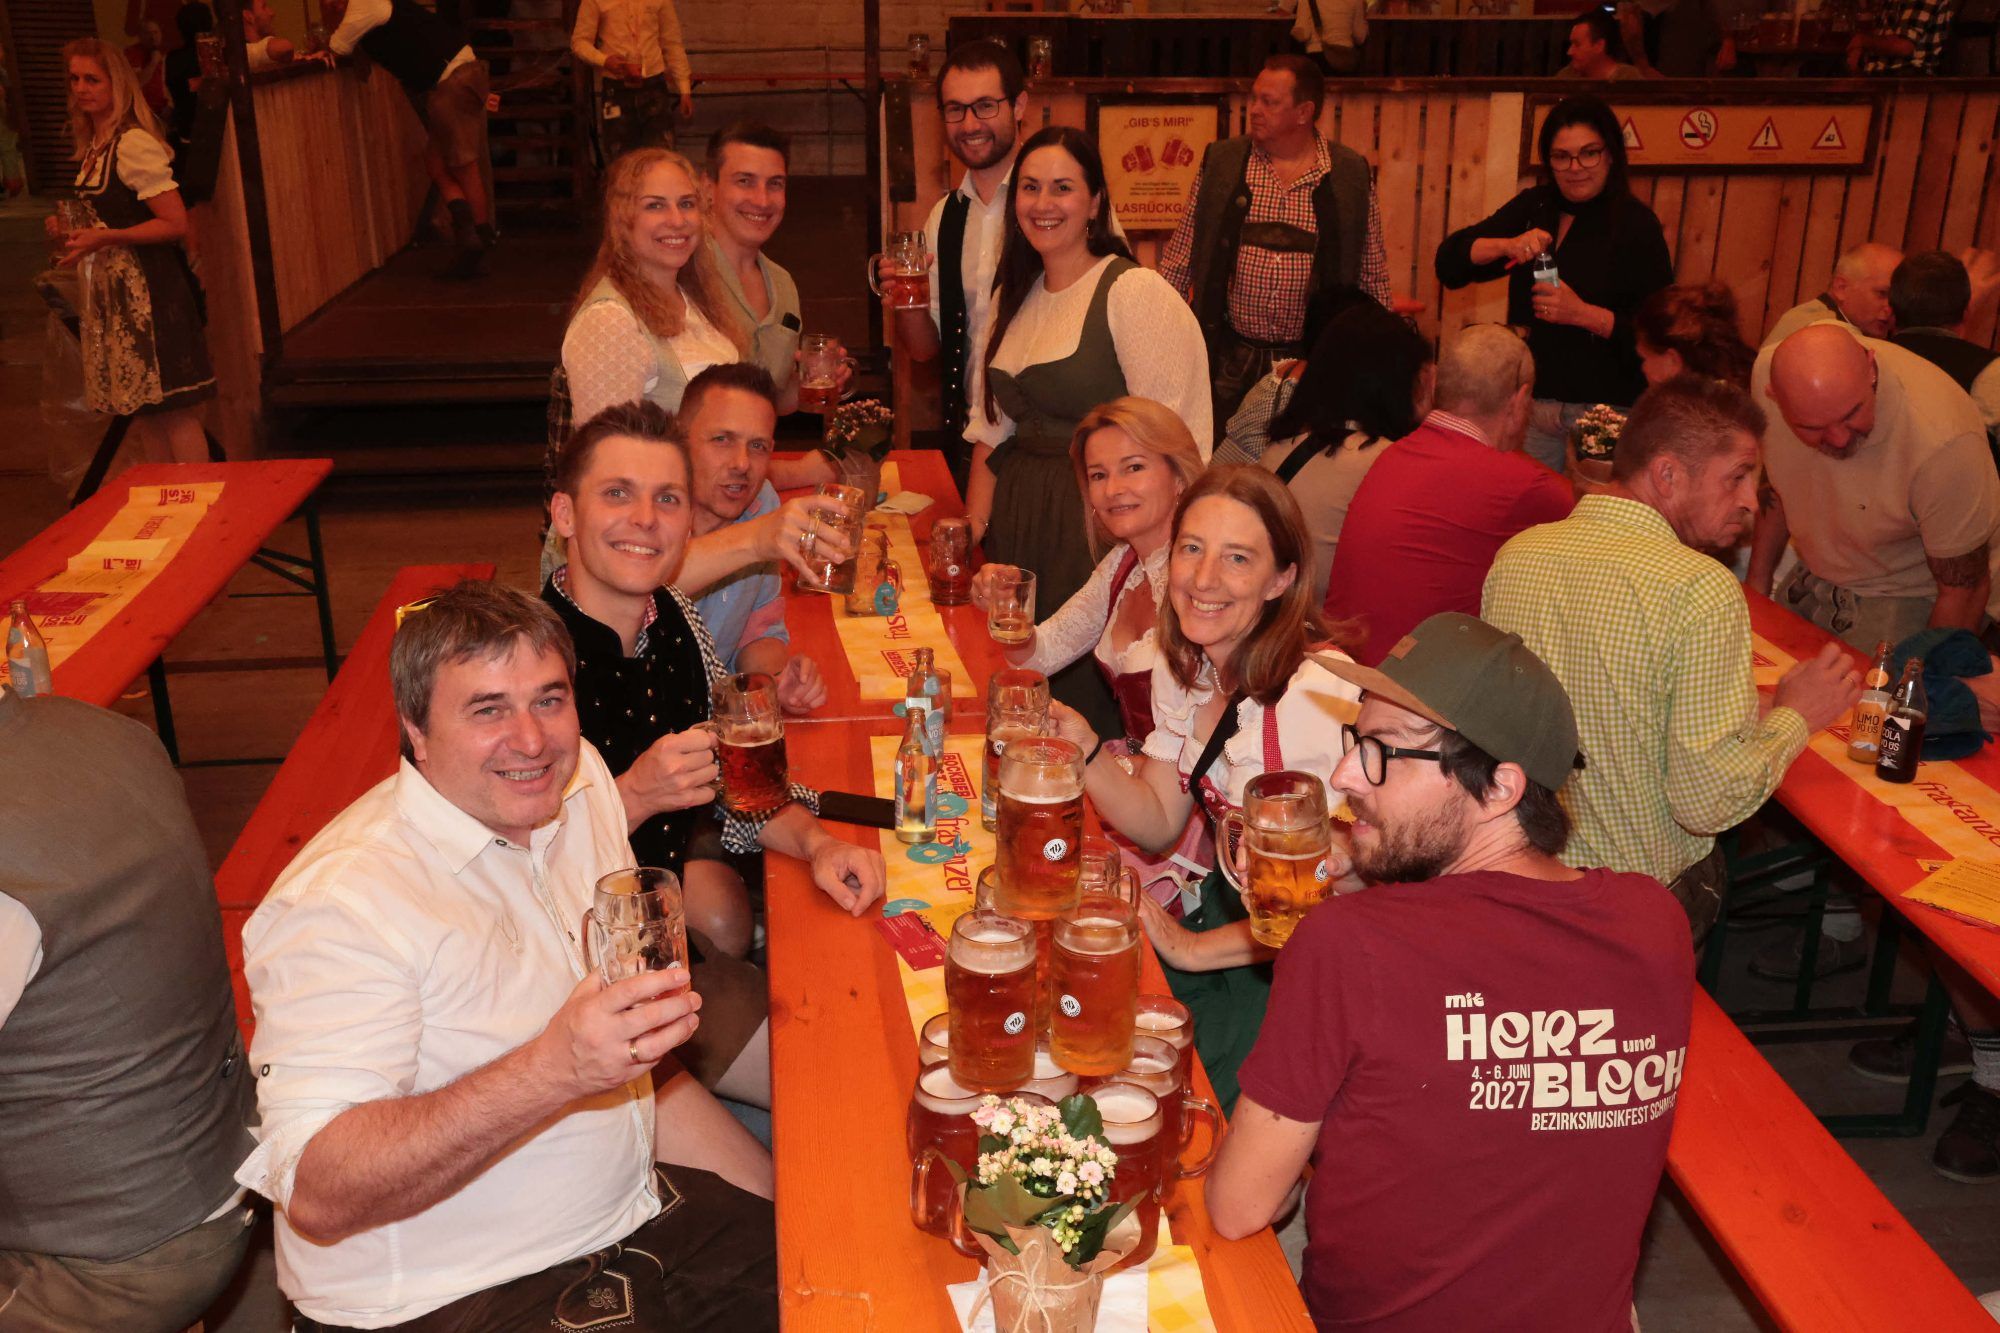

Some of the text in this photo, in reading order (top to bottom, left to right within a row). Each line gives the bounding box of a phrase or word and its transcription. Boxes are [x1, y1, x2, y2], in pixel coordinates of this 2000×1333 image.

[1115, 200, 1187, 214] LASRÜCKG
[1857, 713, 1880, 726] LIMO
[1445, 991, 1485, 1009] mit
[1622, 1034, 1656, 1053] und
[1471, 1065, 1483, 1080] 4.
[1493, 1064, 1505, 1080] 6.
[1507, 1063, 1531, 1080] JUNI
[1469, 1080, 1531, 1110] 2027
[1531, 1105, 1649, 1131] BEZIRKSMUSIKFEST
